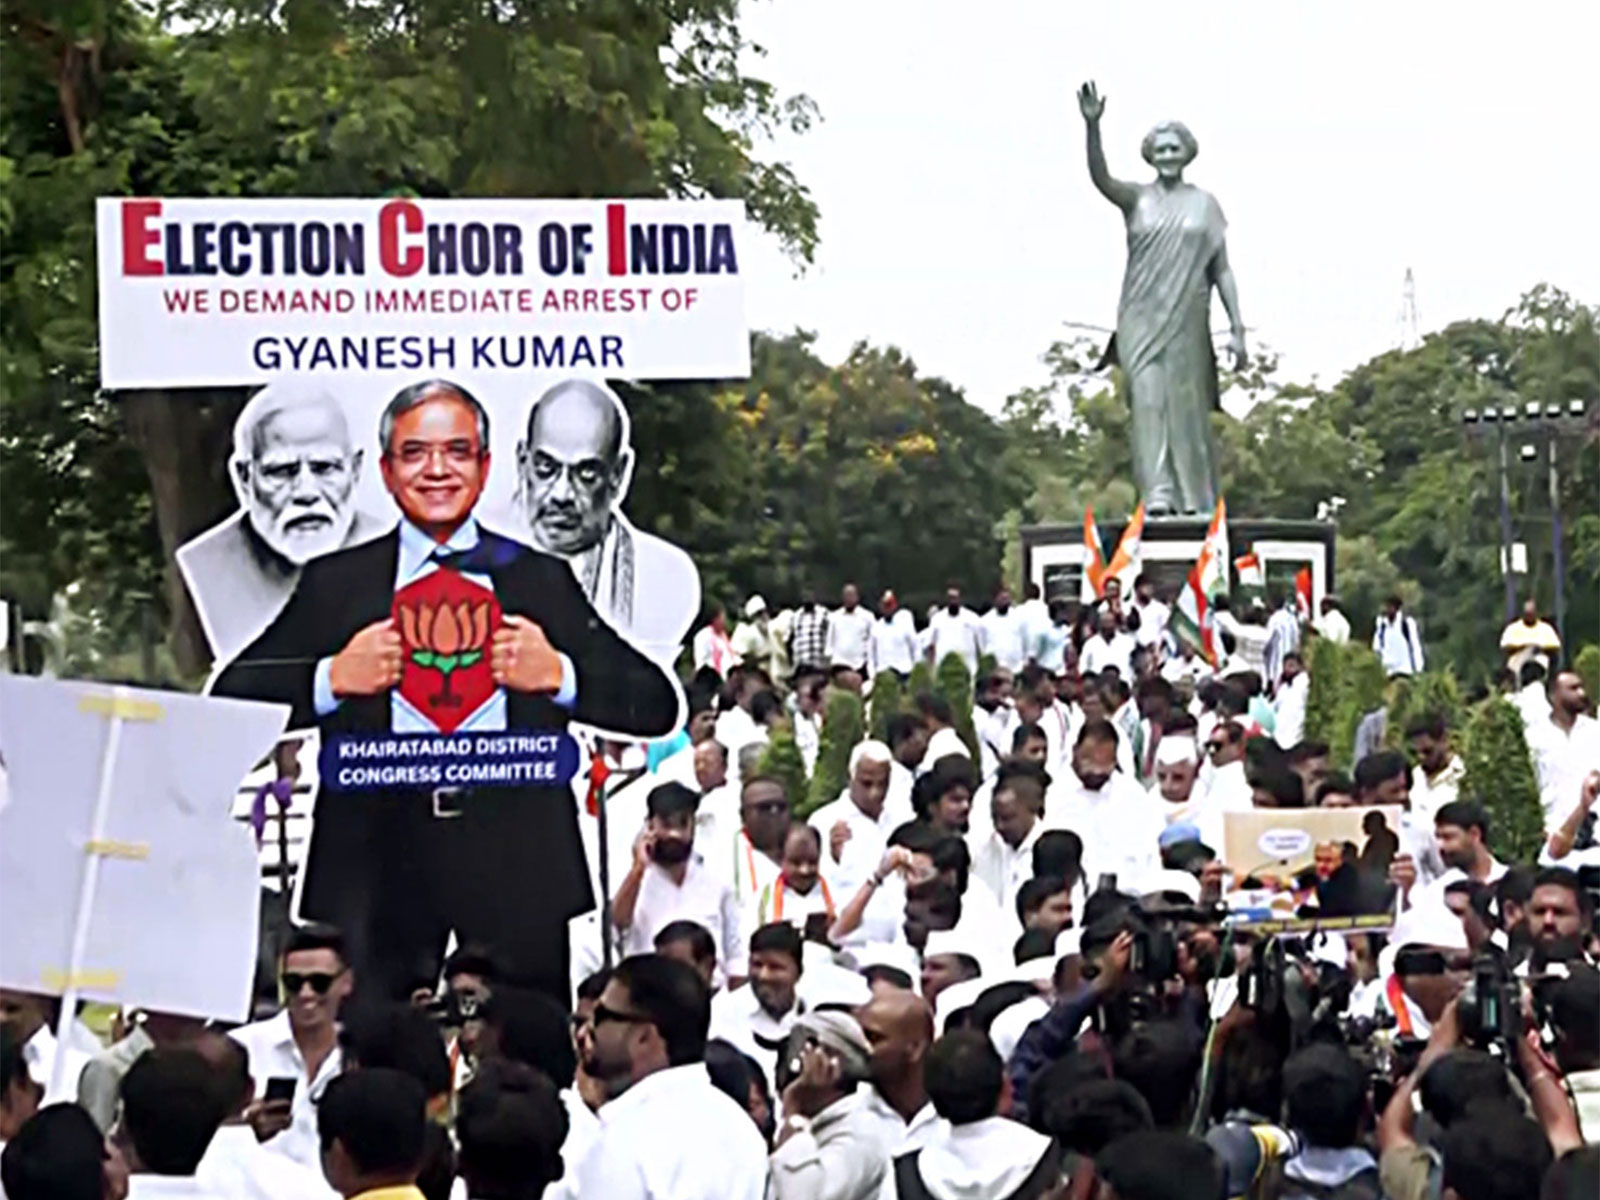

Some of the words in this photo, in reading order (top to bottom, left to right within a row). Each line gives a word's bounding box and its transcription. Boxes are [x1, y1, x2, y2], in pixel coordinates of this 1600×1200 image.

[121, 200, 364, 277] ELECTION
[378, 200, 522, 277] CHOR
[539, 221, 592, 275] OF
[606, 203, 738, 276] INDIA
[164, 290, 210, 314] WE
[220, 289, 355, 313] DEMAND
[364, 289, 533, 313] IMMEDIATE
[541, 288, 653, 312] ARREST
[661, 287, 699, 311] OF
[252, 337, 456, 371] GYANESH
[472, 335, 625, 369] KUMAR
[339, 740, 472, 758] KHAIRATABAD
[476, 736, 559, 755] DISTRICT
[339, 767, 441, 785] CONGRESS
[445, 762, 556, 782] COMMITTEE
